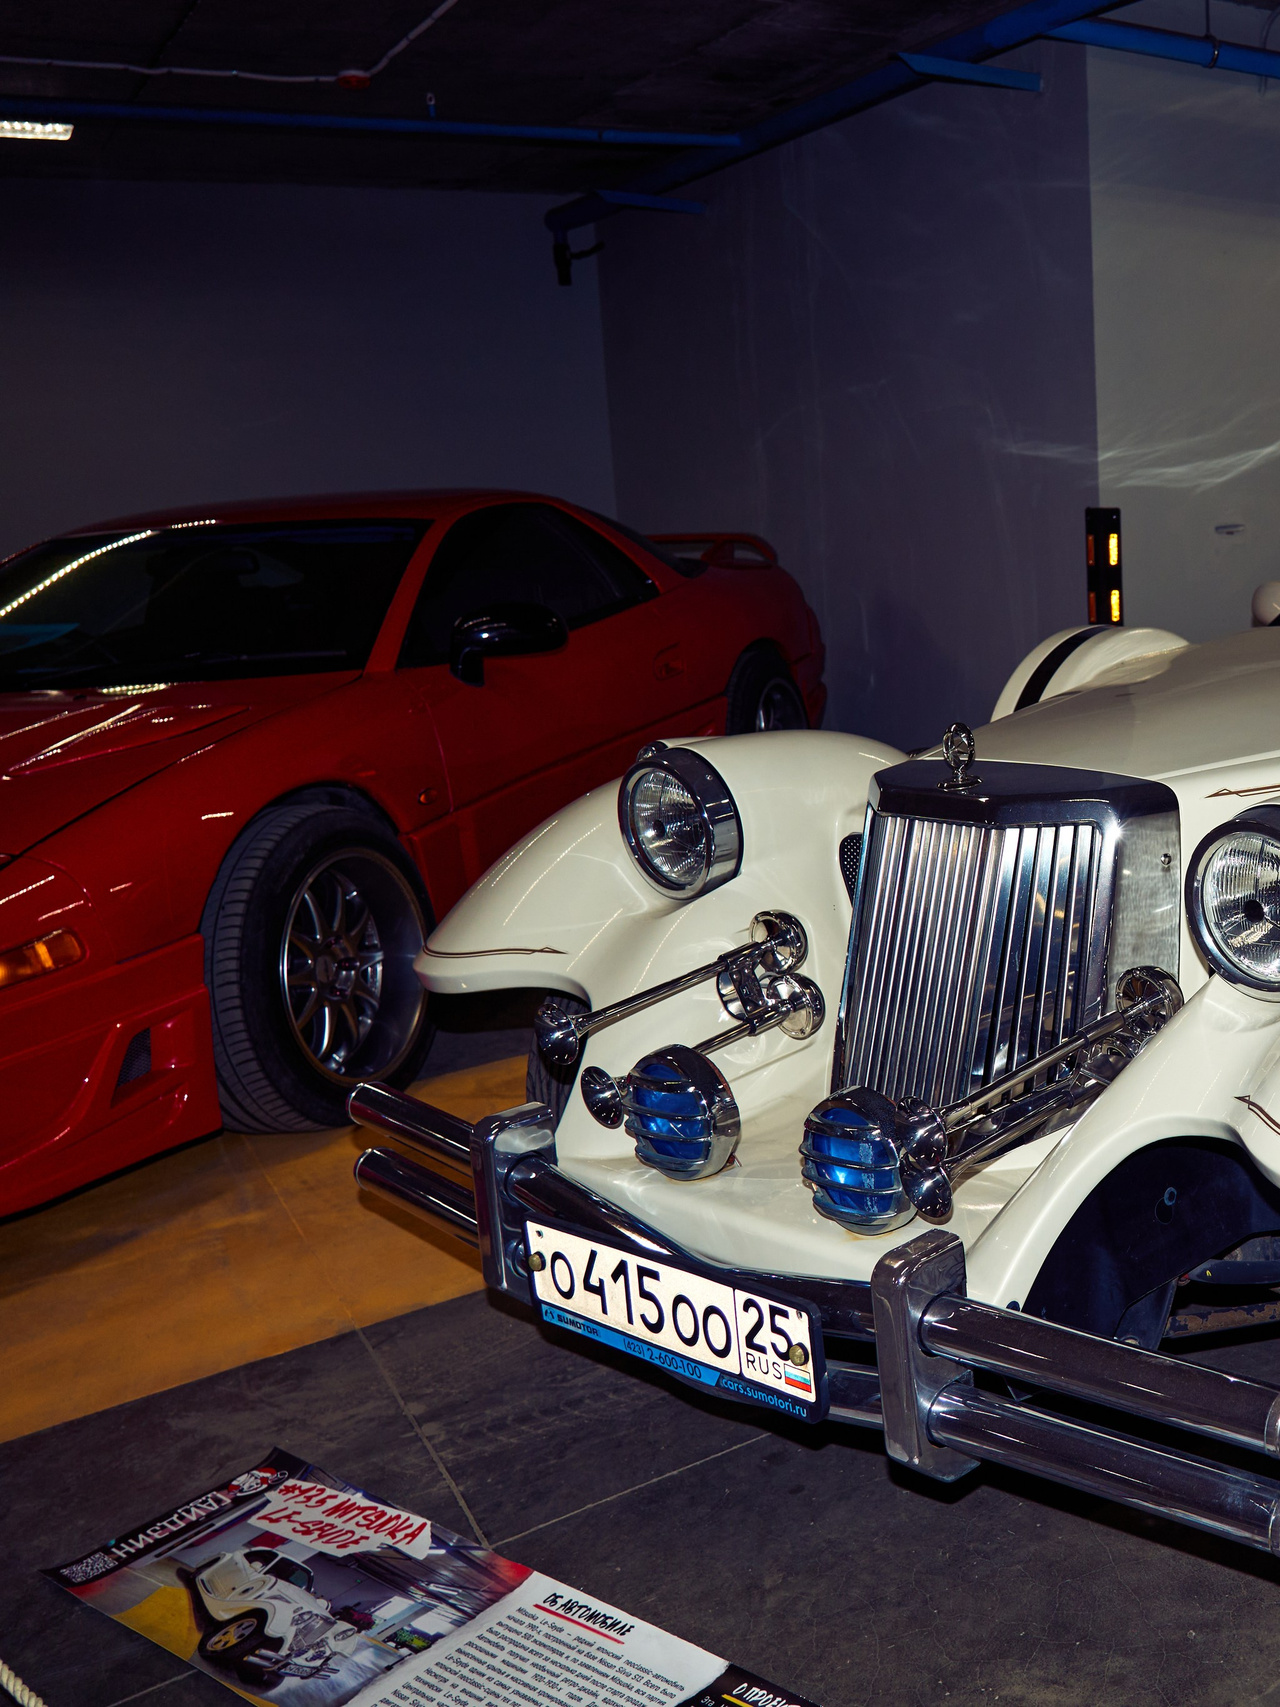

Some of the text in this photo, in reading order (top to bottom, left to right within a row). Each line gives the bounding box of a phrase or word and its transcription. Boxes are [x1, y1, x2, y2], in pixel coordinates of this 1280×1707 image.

[742, 1298, 795, 1362] 25
[622, 1337, 702, 1380] (423) 2-600-100
[746, 1352, 783, 1380] RUS
[721, 1376, 808, 1418] cars.sumotori.ru
[111, 1490, 232, 1559] ГАЙДЗИН
[257, 1506, 371, 1550] LE-SEYDE
[278, 1484, 427, 1547] #135 MITSUOKA
[542, 1592, 635, 1636] ОБ АВТОМОБИЛЕ
[732, 1683, 748, 1695] О
